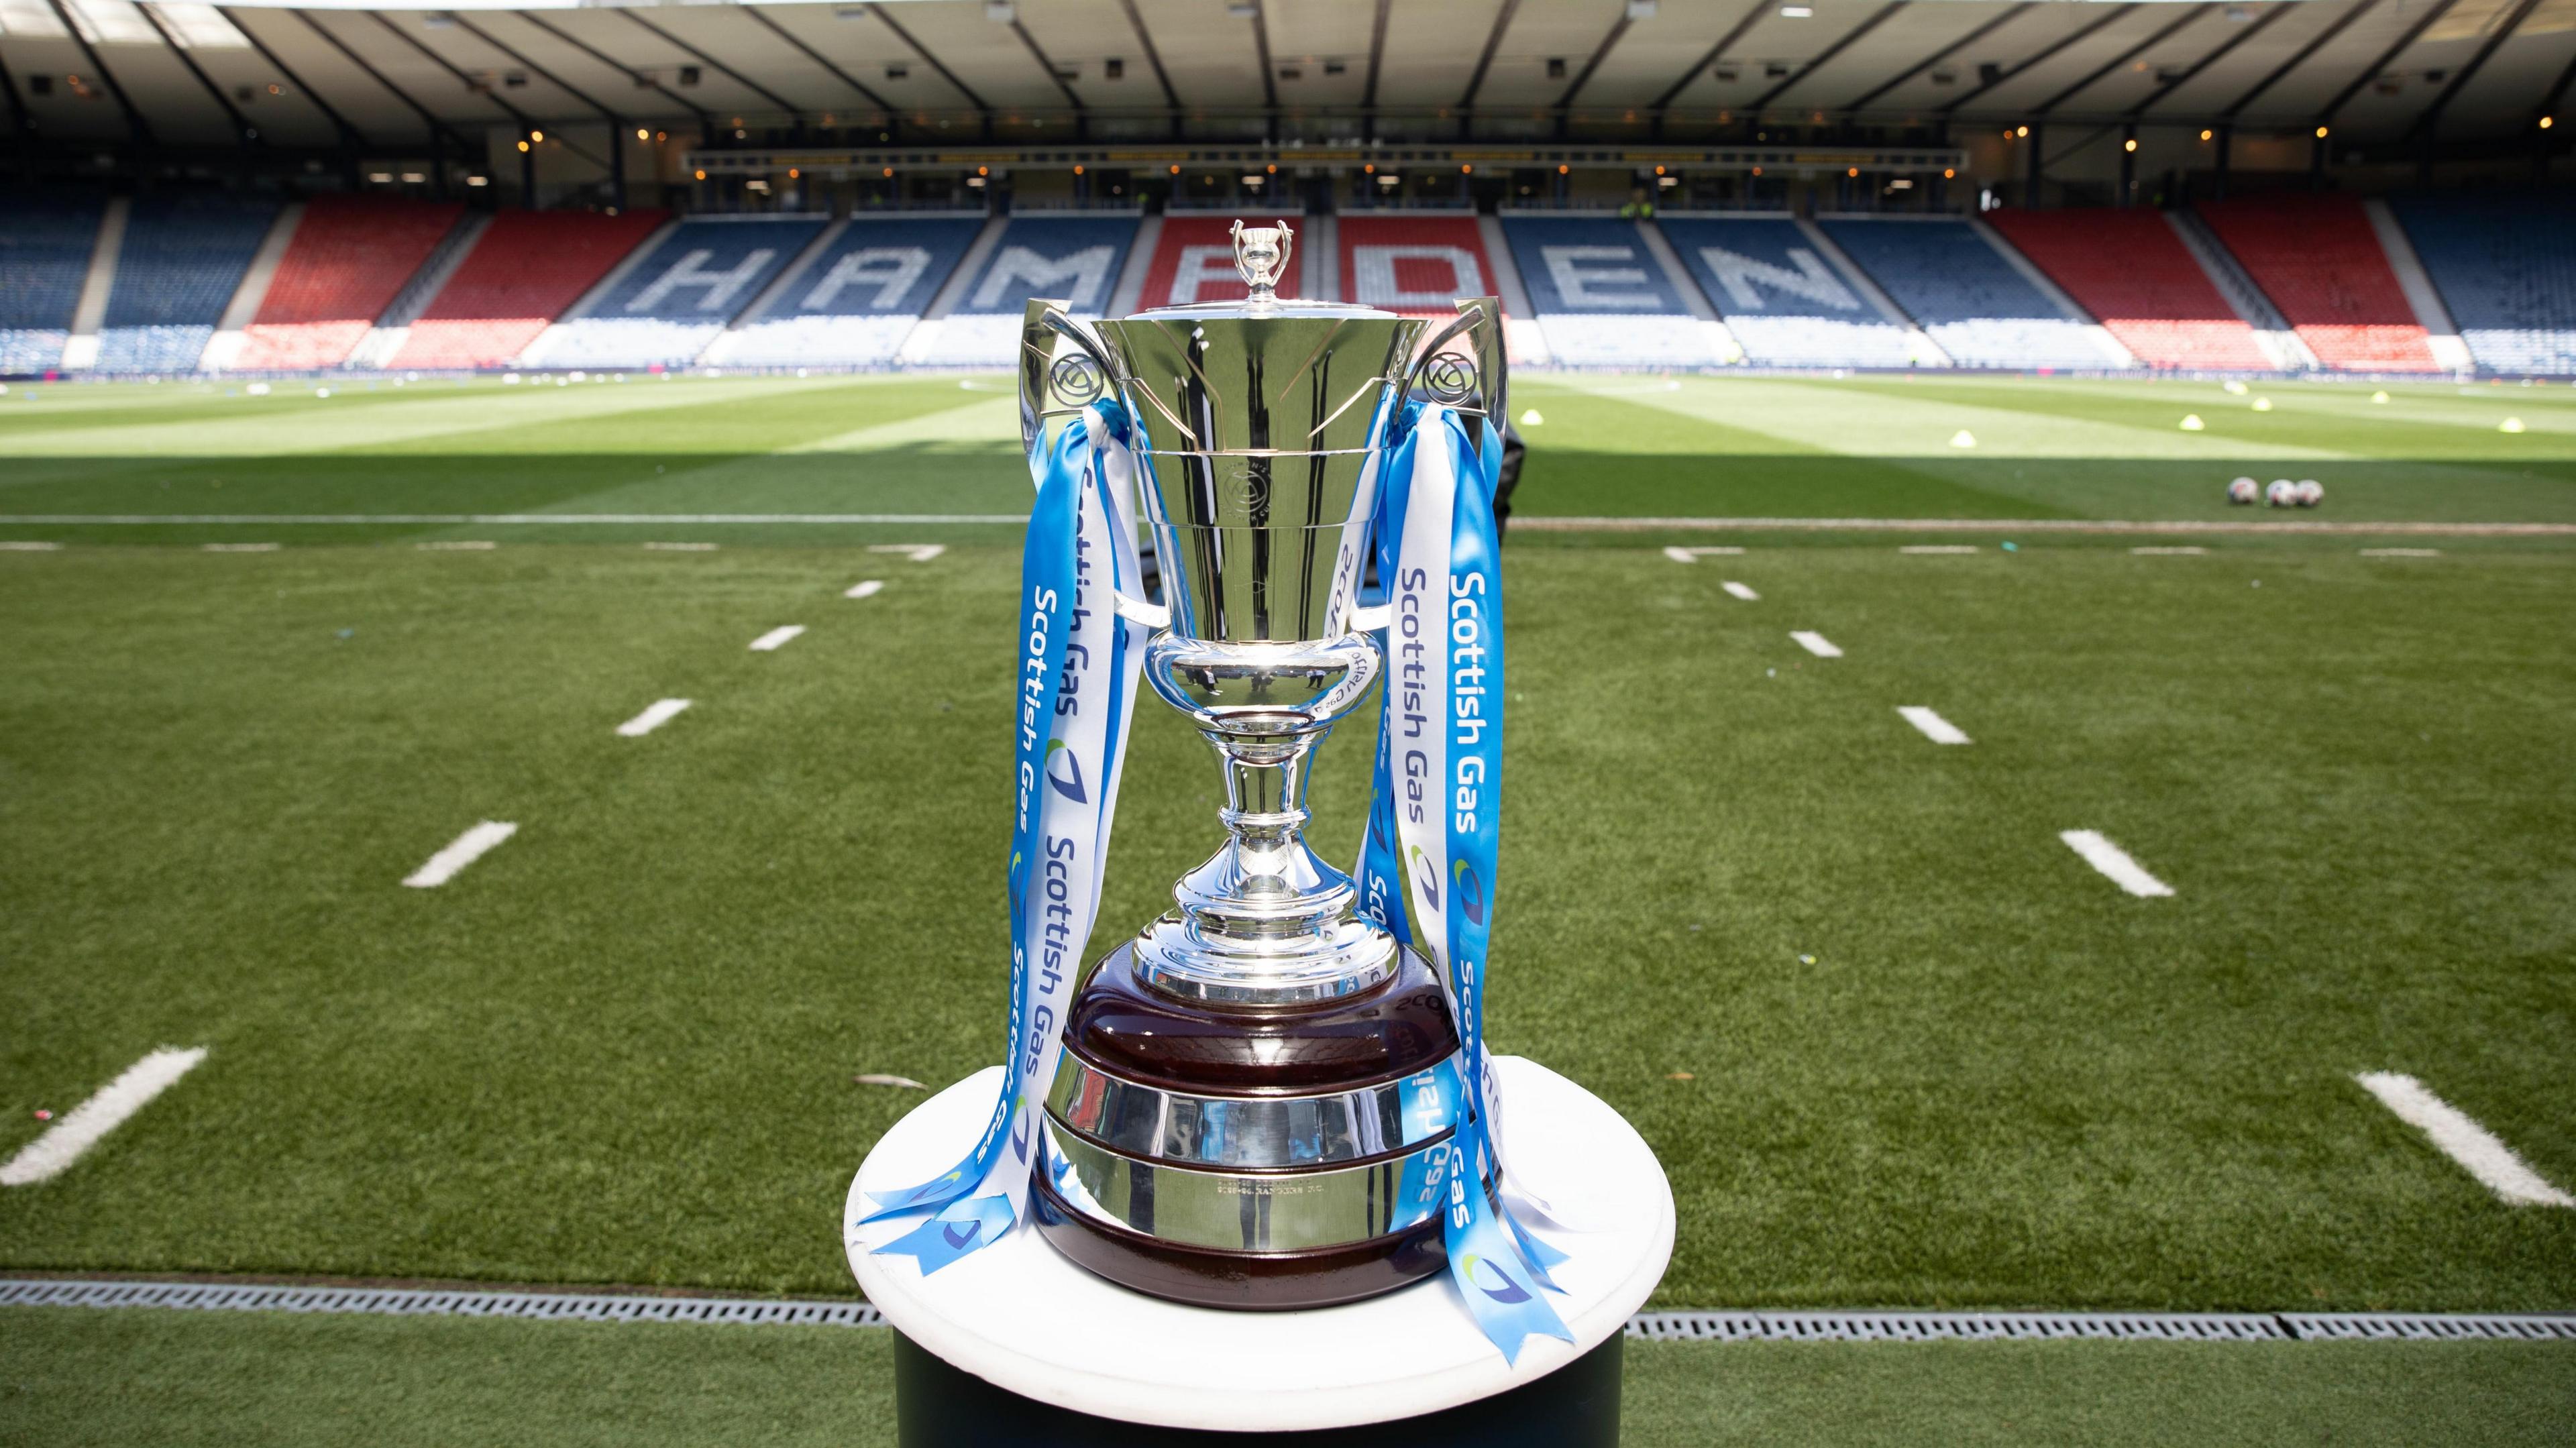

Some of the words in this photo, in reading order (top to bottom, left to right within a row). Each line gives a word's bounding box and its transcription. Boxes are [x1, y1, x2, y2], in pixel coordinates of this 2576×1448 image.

[625, 245, 1862, 313] HAMPDEN
[1023, 585, 1057, 752] Scottish
[1401, 568, 1428, 738] Scottish
[1450, 571, 1487, 744] Scottish
[1020, 761, 1034, 834] Gas
[1405, 750, 1428, 825] Gas
[1456, 757, 1485, 834] Gas
[1038, 836, 1075, 995] Scottish
[1006, 940, 1024, 1095] Scottish
[1026, 1005, 1054, 1078] Gas
[977, 1099, 1007, 1165] Gas
[1451, 1147, 1470, 1229] Gas
